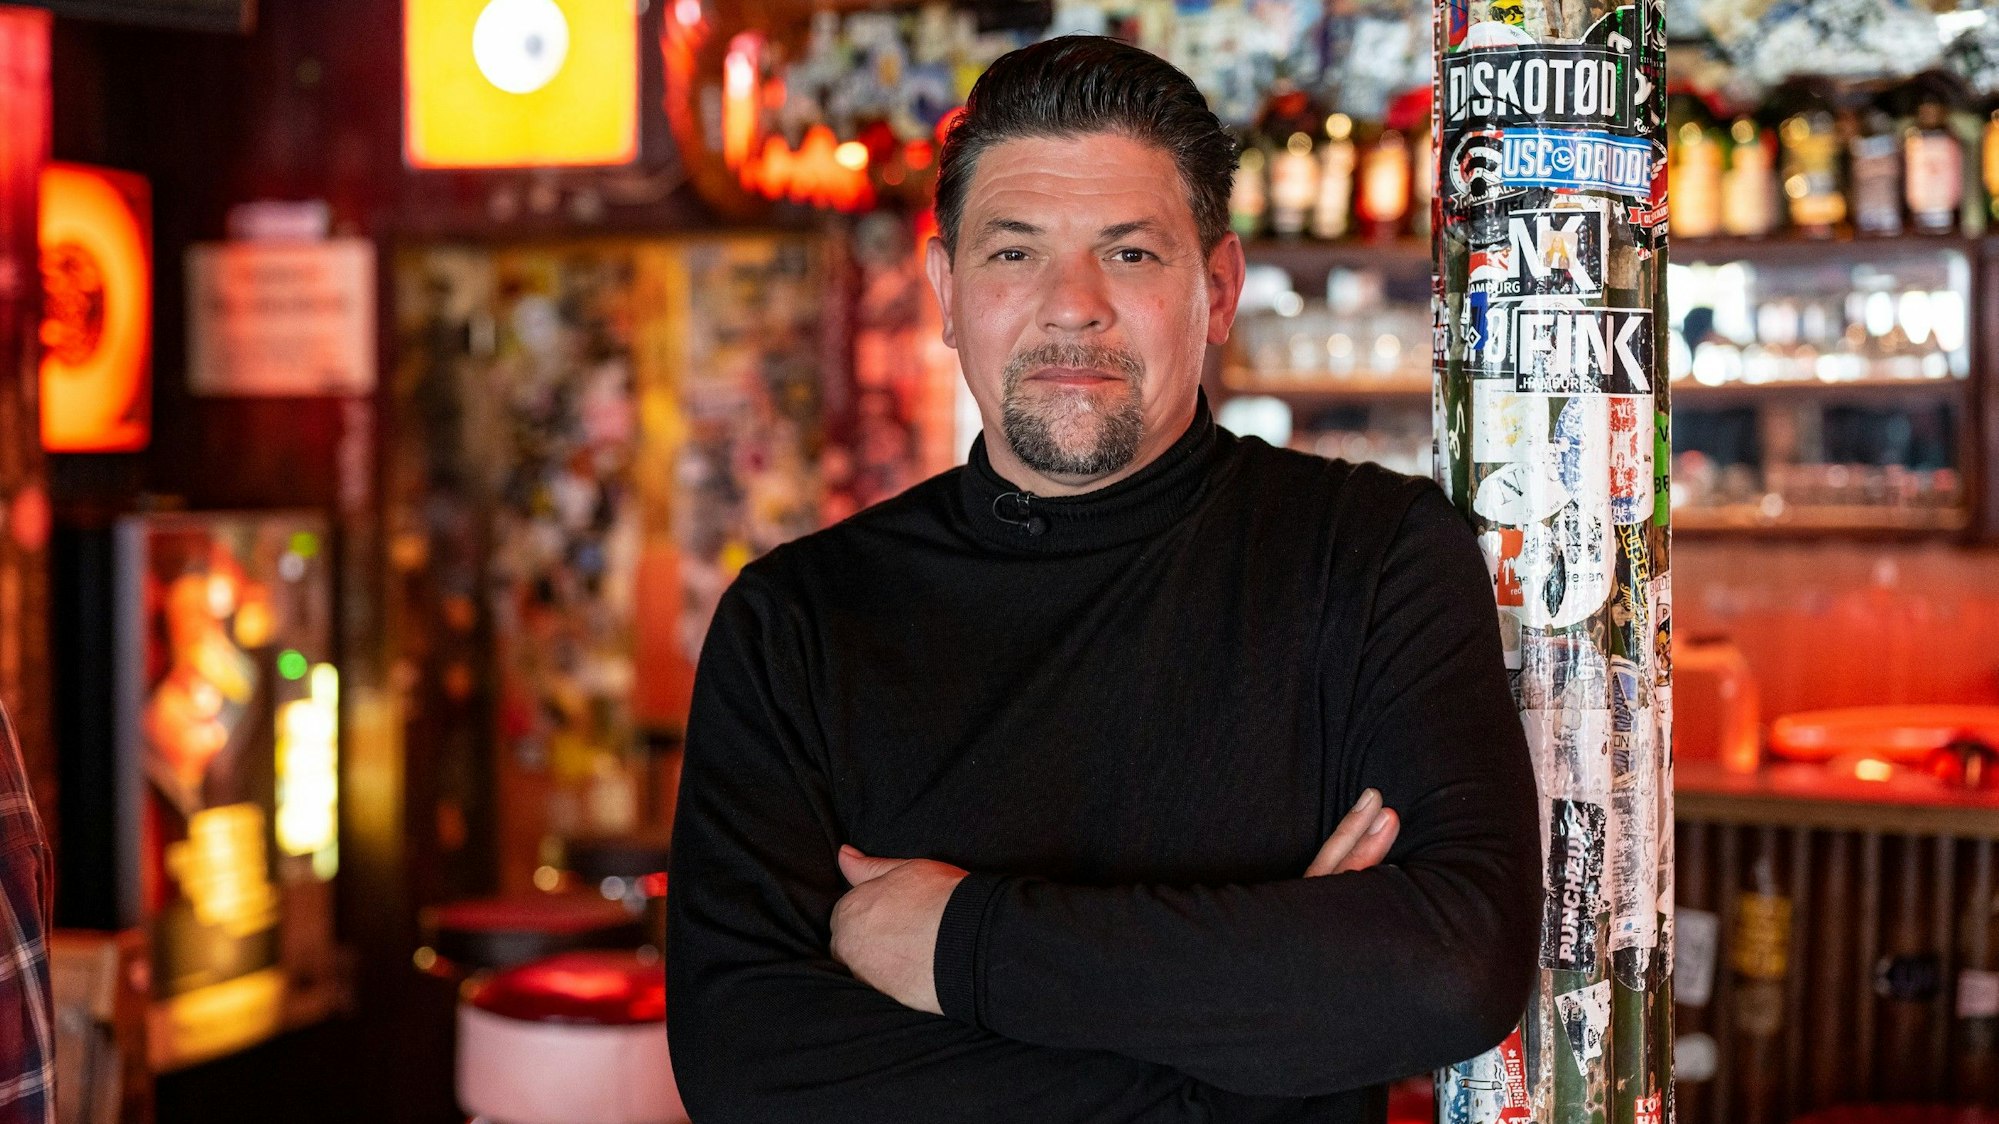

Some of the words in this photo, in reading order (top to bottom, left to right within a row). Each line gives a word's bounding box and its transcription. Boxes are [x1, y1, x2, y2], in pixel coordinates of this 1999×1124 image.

[1503, 138, 1554, 177] USC
[1470, 280, 1520, 294] AMBURG
[1519, 312, 1651, 392] FINK
